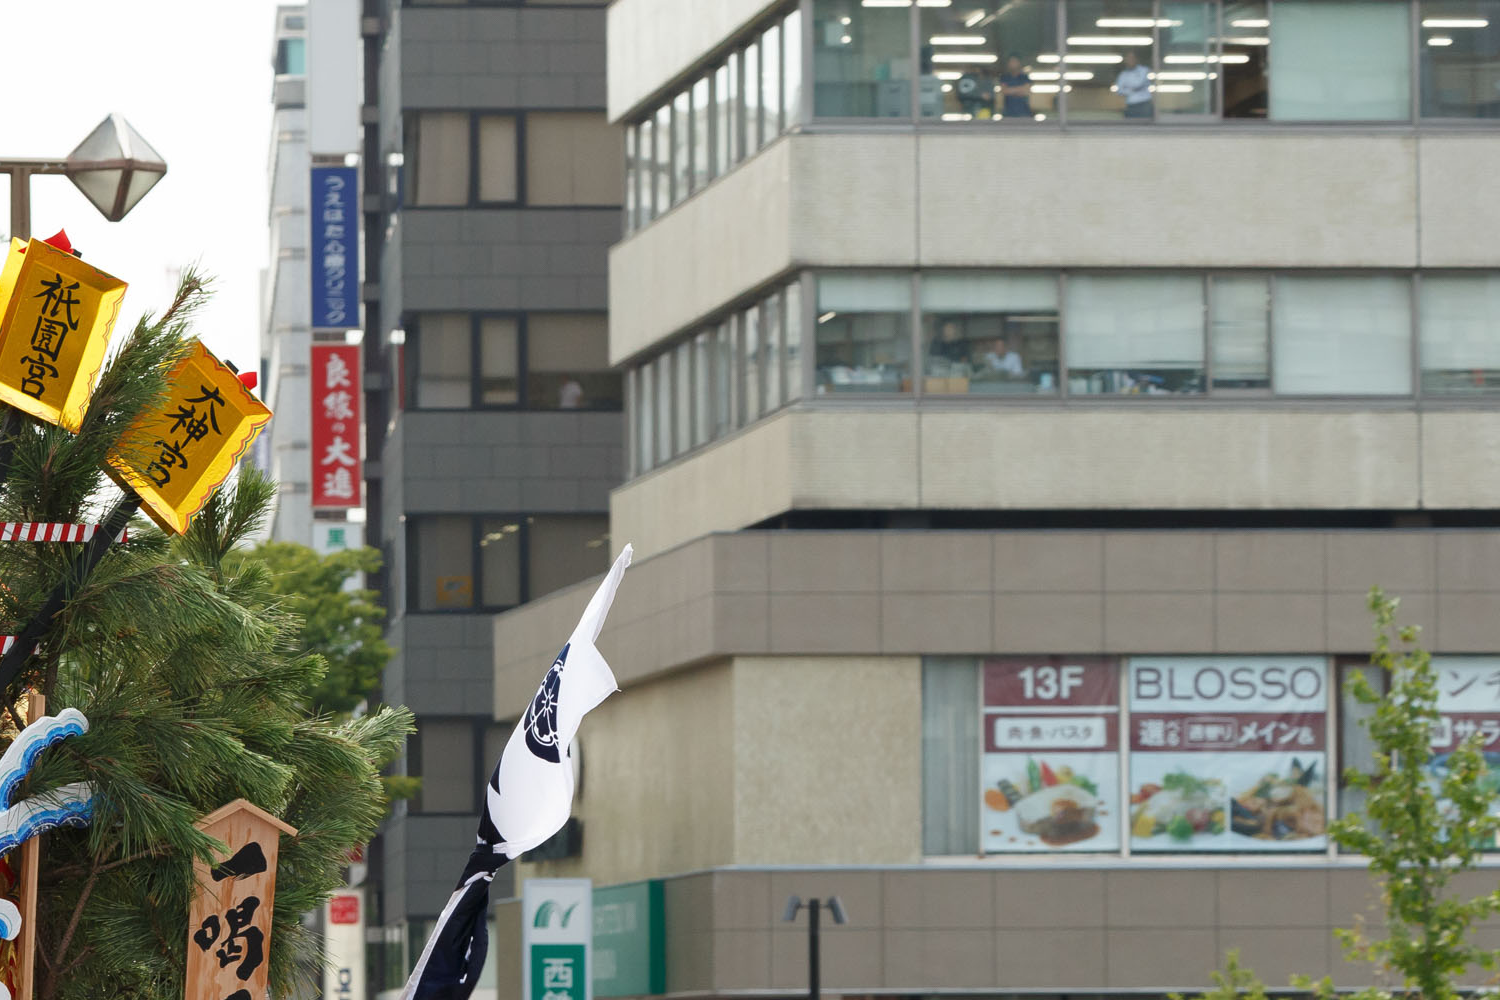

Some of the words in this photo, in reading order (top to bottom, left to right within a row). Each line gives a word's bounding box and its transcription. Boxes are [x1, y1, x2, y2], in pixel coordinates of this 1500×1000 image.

[20, 273, 81, 401] 祇園宮
[146, 384, 225, 489] 大神宮
[1017, 666, 1084, 699] 13F
[1135, 666, 1321, 700] BLOSSO
